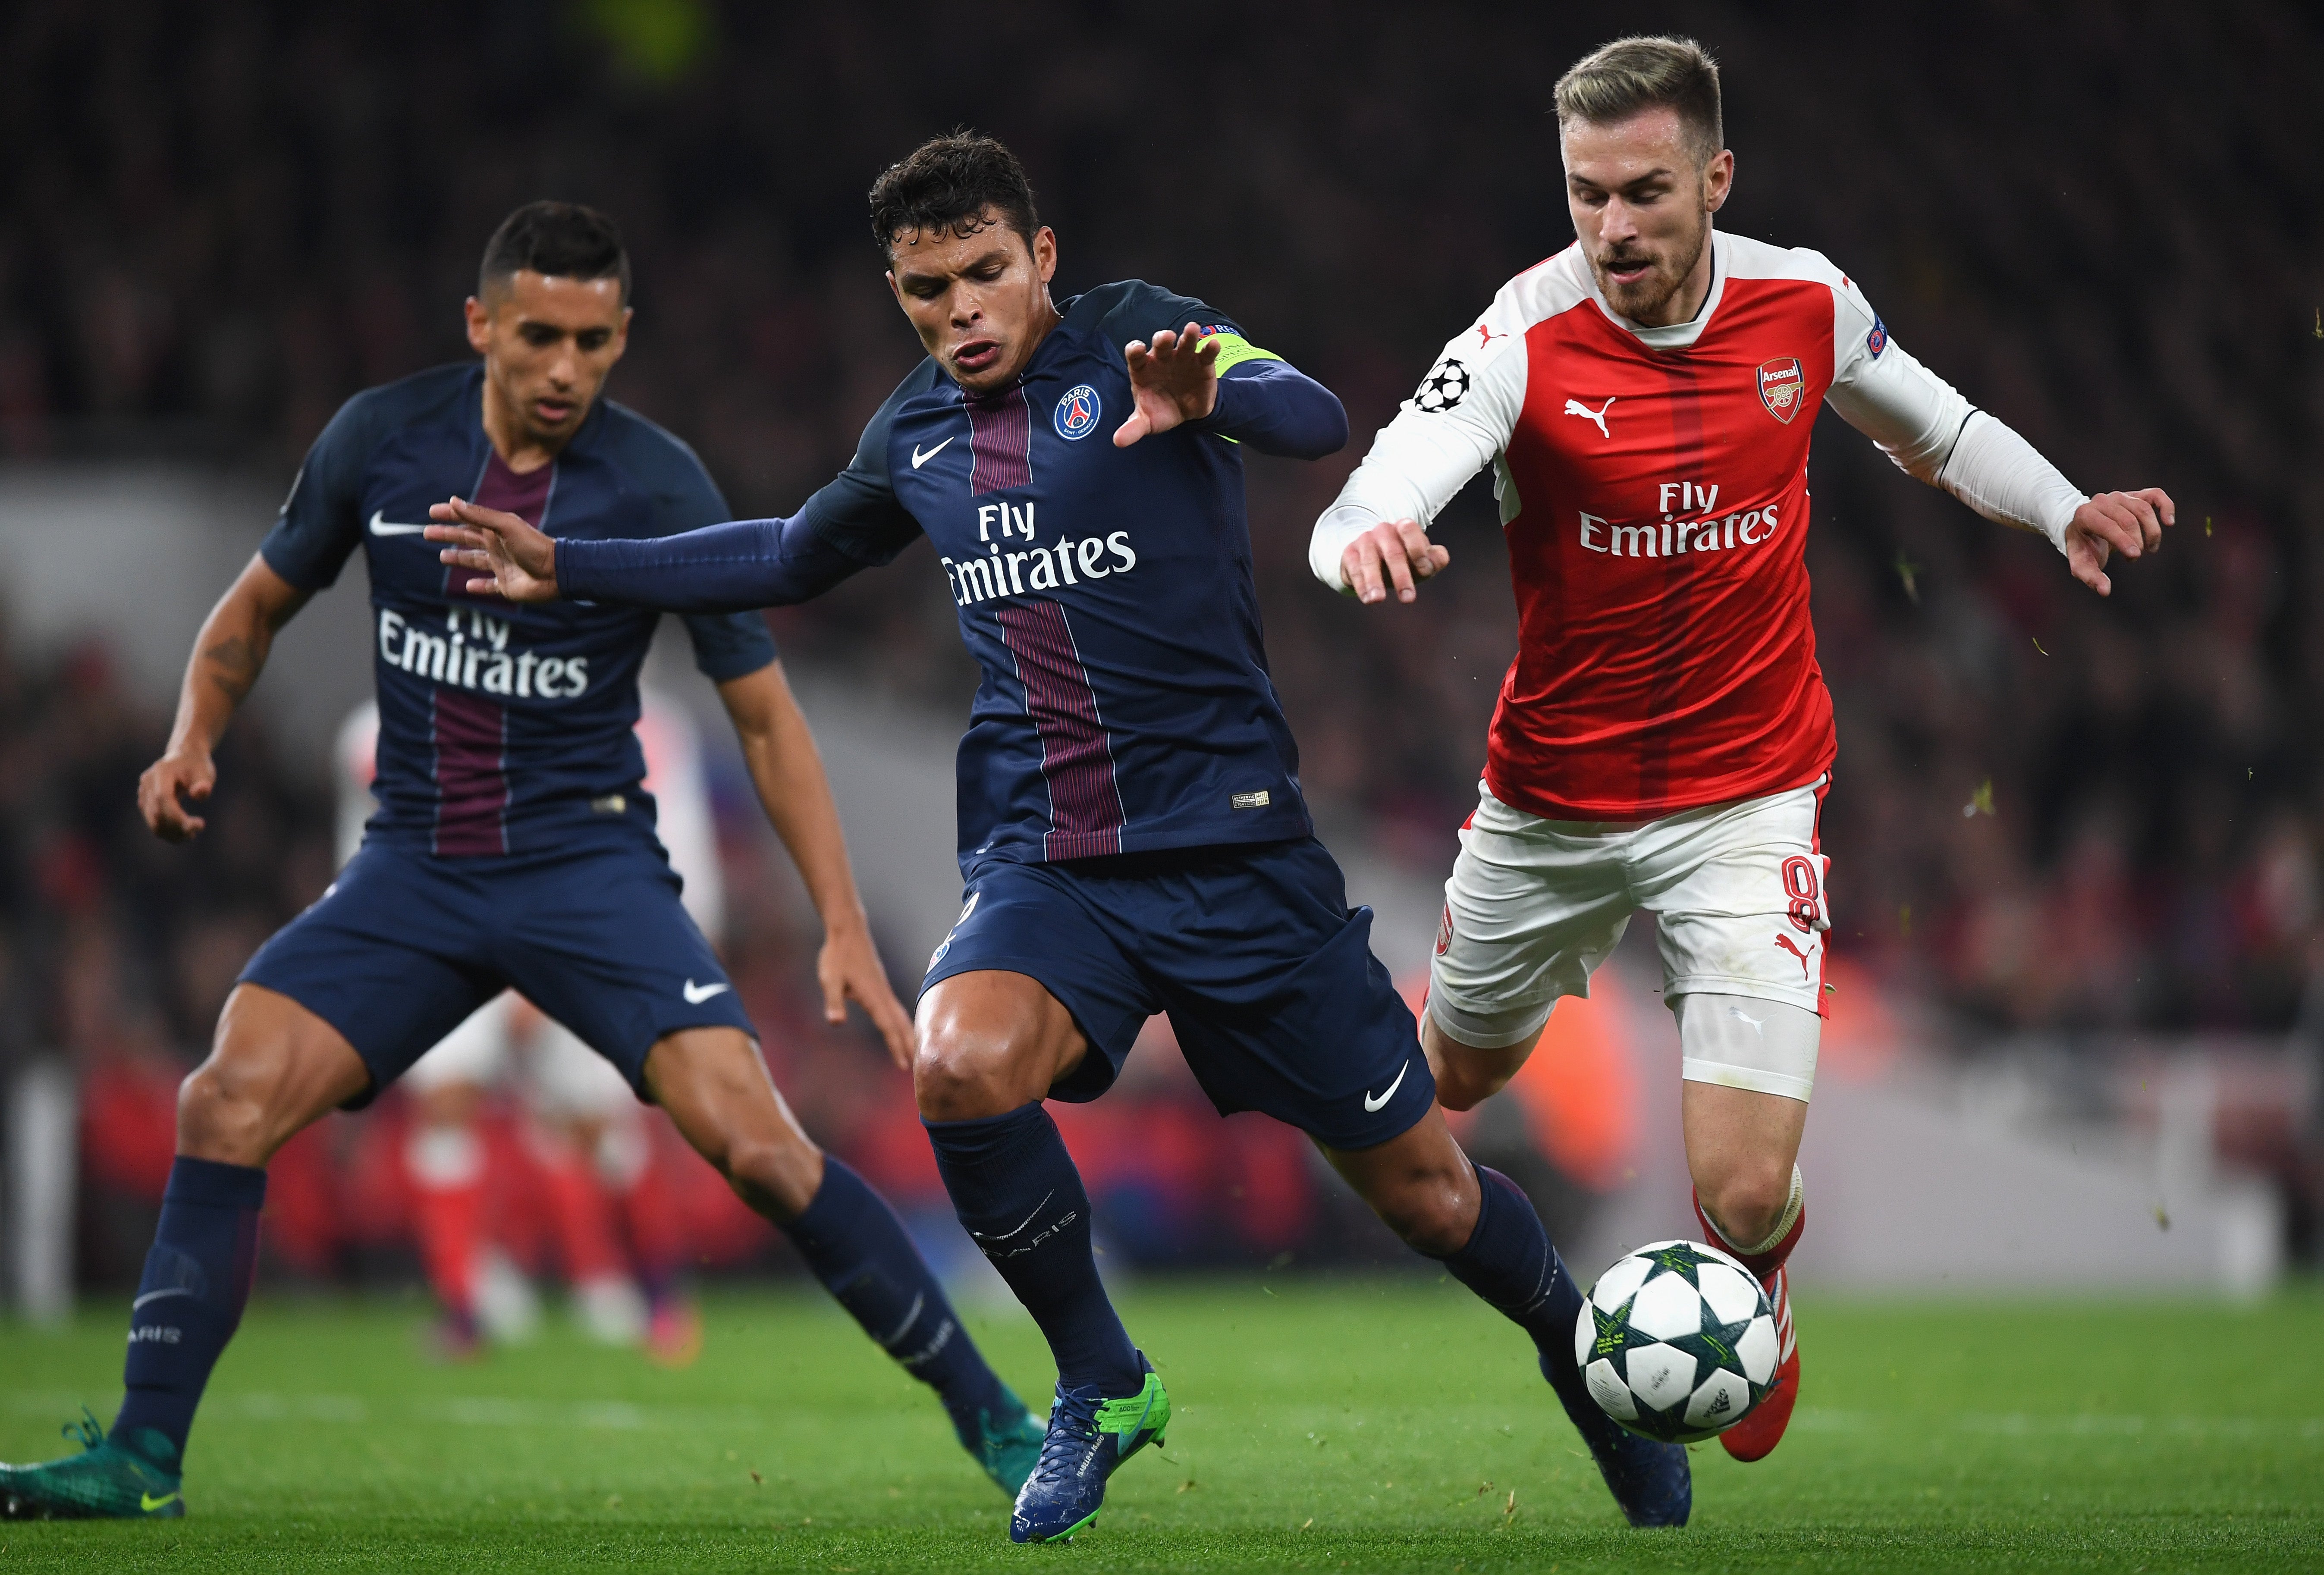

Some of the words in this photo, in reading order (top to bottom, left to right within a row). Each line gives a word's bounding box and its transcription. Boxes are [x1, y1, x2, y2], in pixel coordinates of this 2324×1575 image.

[1215, 348, 1253, 362] SPECT
[1763, 366, 1796, 383] Arsenal
[1061, 388, 1090, 406] PARIS
[1078, 418, 1094, 434] GERMAIN
[1659, 481, 1718, 514] Fly
[978, 502, 1035, 542] Fly
[1578, 505, 1778, 557] Emirates
[940, 531, 1137, 606] Emirates
[380, 608, 588, 699] Emirates
[1781, 855, 1820, 934] 8
